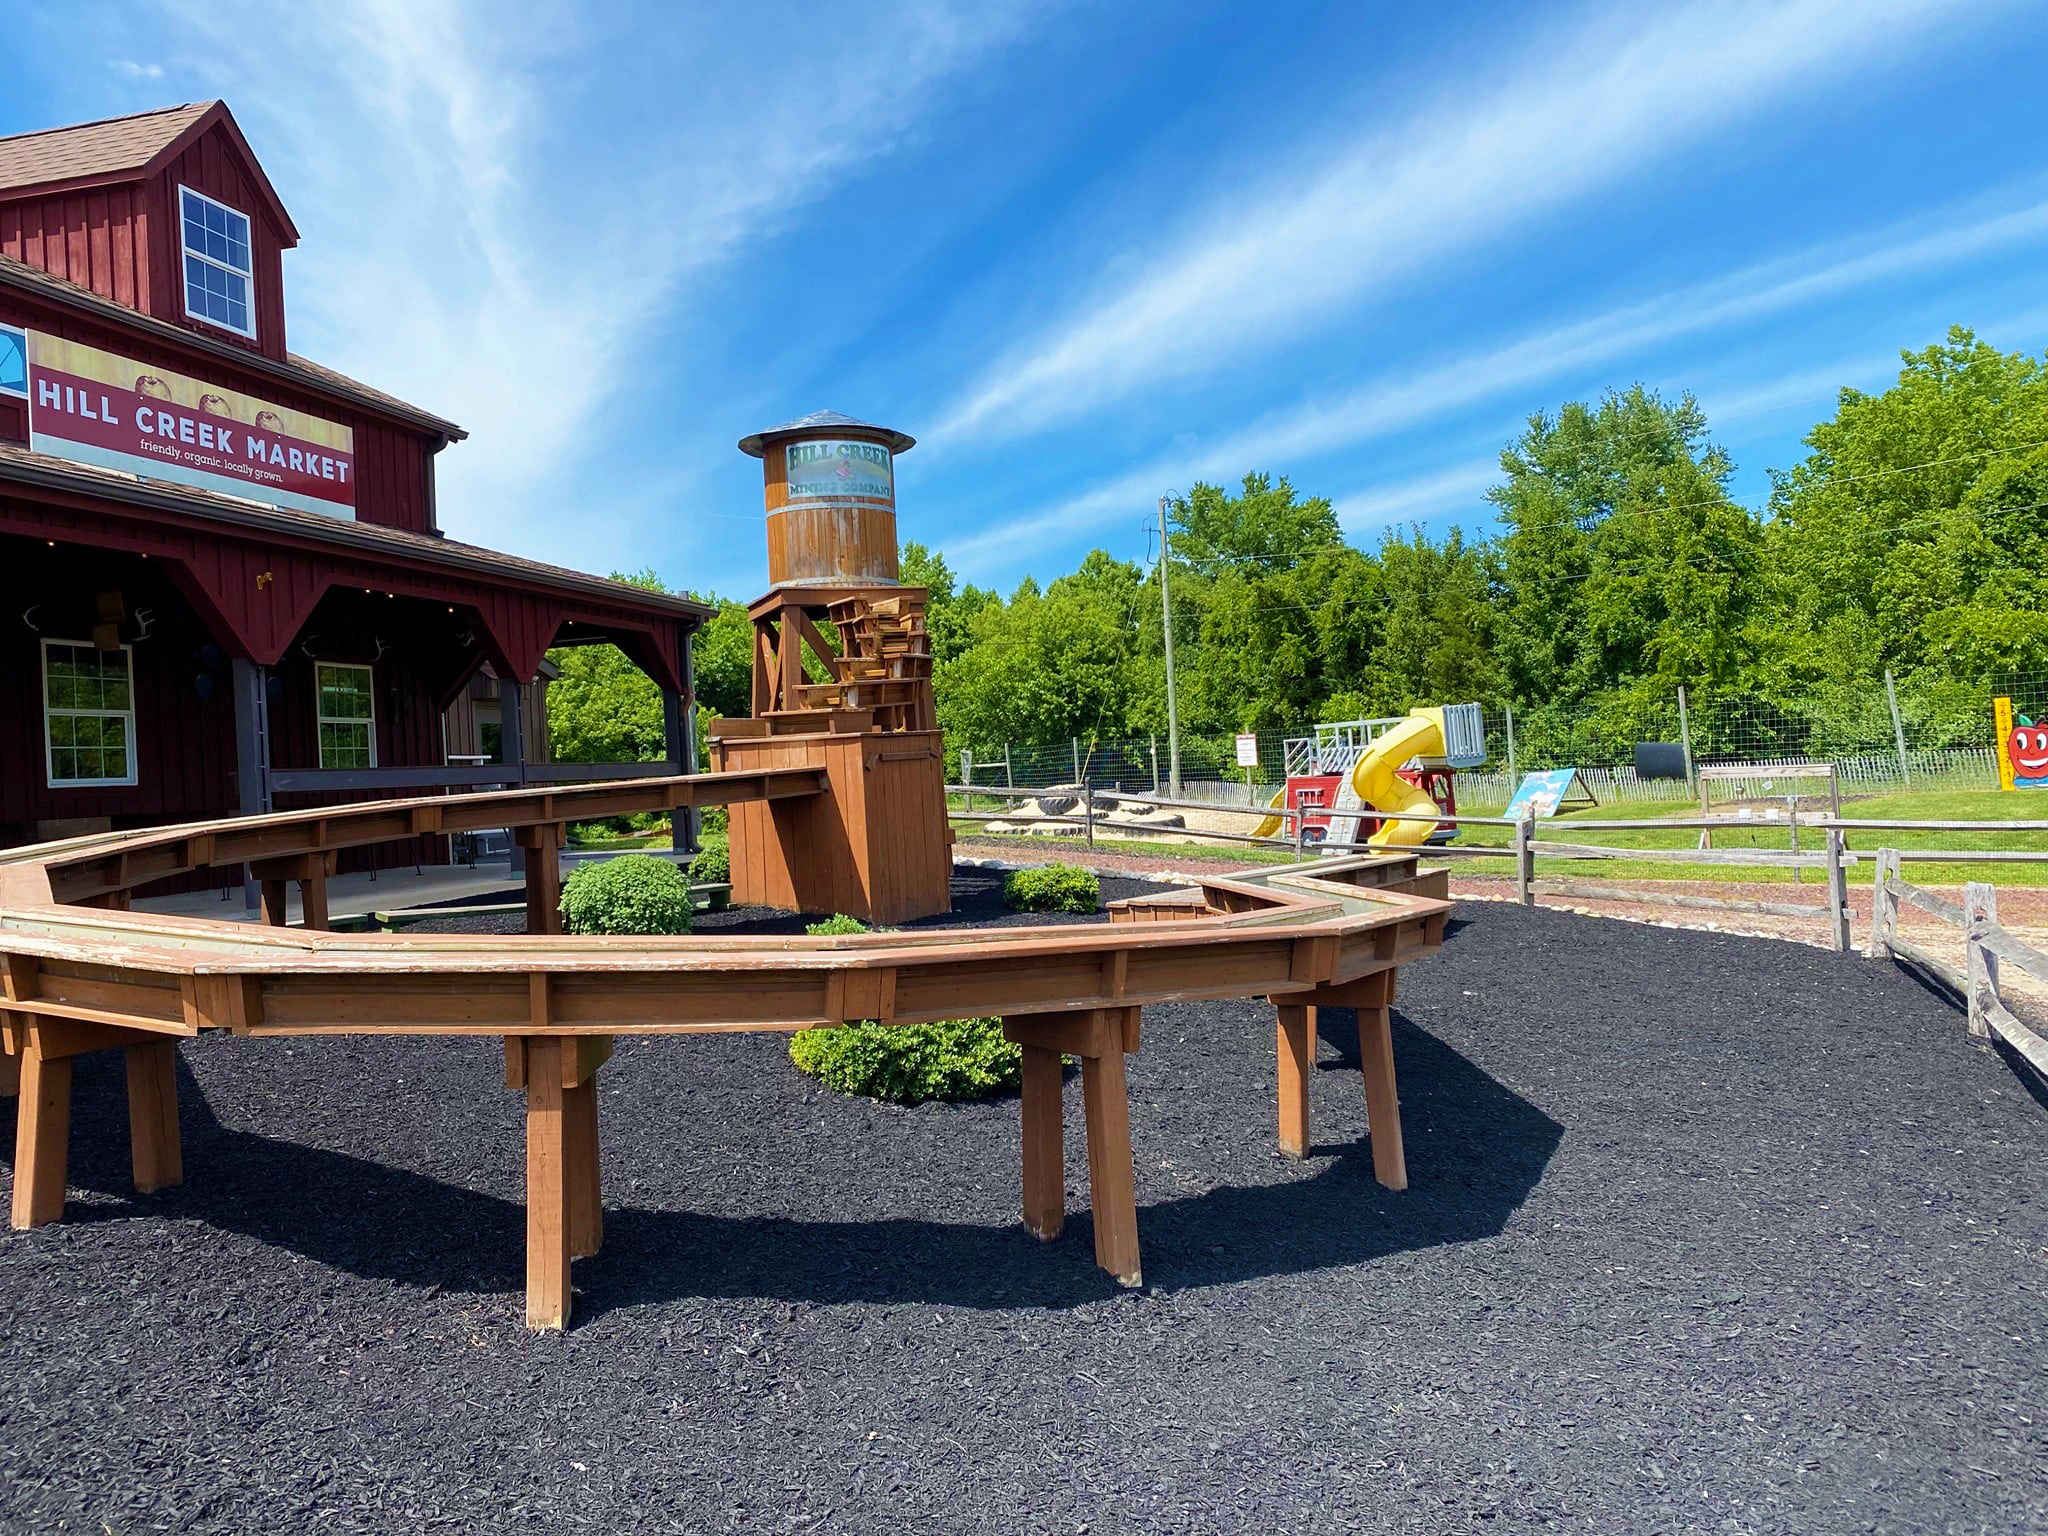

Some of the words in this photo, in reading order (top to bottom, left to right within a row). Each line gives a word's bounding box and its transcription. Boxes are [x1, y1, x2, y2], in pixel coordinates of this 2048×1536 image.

[38, 378, 119, 425] HILL
[135, 406, 234, 455] CREEK
[246, 435, 349, 483] MARKET
[140, 438, 182, 460] friendly.
[184, 449, 223, 468] organic.
[224, 459, 254, 479] locally
[254, 469, 284, 483] grown.
[788, 444, 833, 472] HILL
[836, 444, 890, 473] CREEK
[789, 482, 838, 495] MINING
